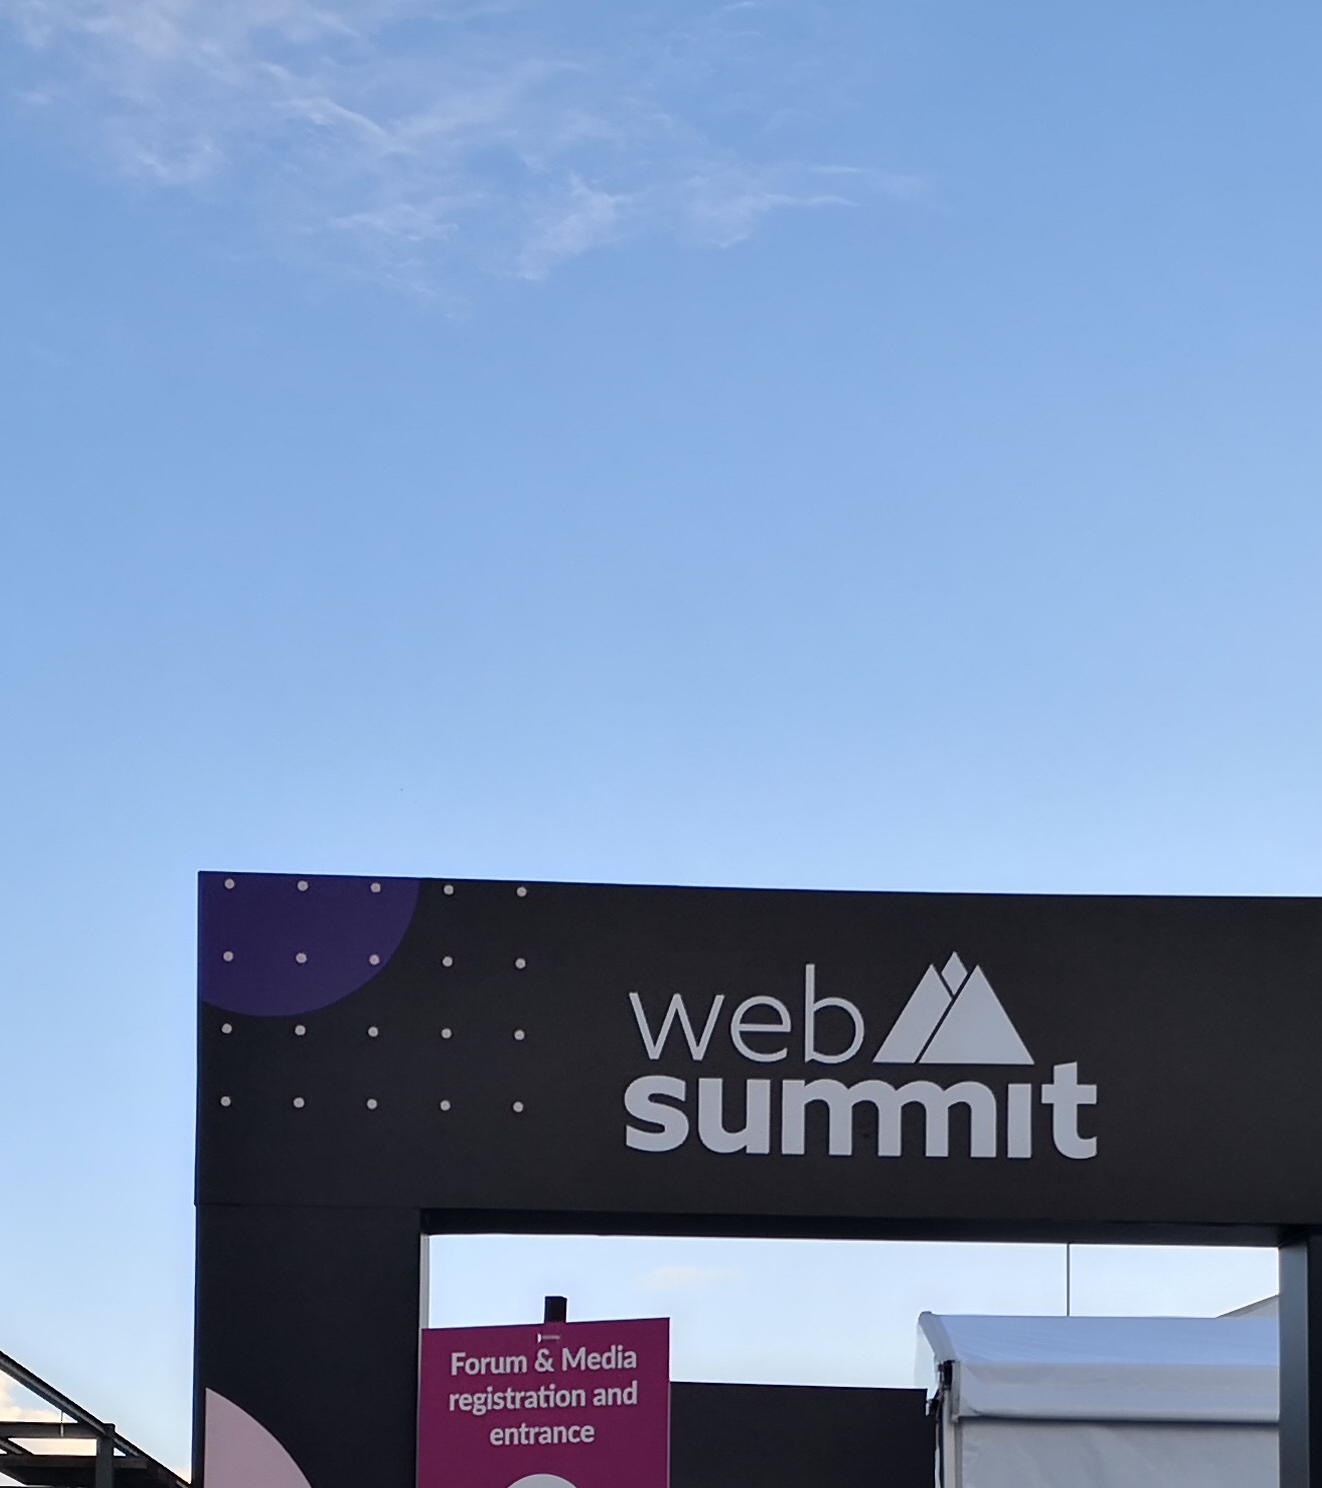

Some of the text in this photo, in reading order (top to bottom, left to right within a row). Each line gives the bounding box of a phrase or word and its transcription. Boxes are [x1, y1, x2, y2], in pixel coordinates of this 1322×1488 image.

[628, 963, 865, 1064] web
[623, 1061, 1098, 1160] summit
[450, 1345, 637, 1376] Forum & Media
[448, 1380, 638, 1416] registration and
[489, 1422, 595, 1446] entrance
